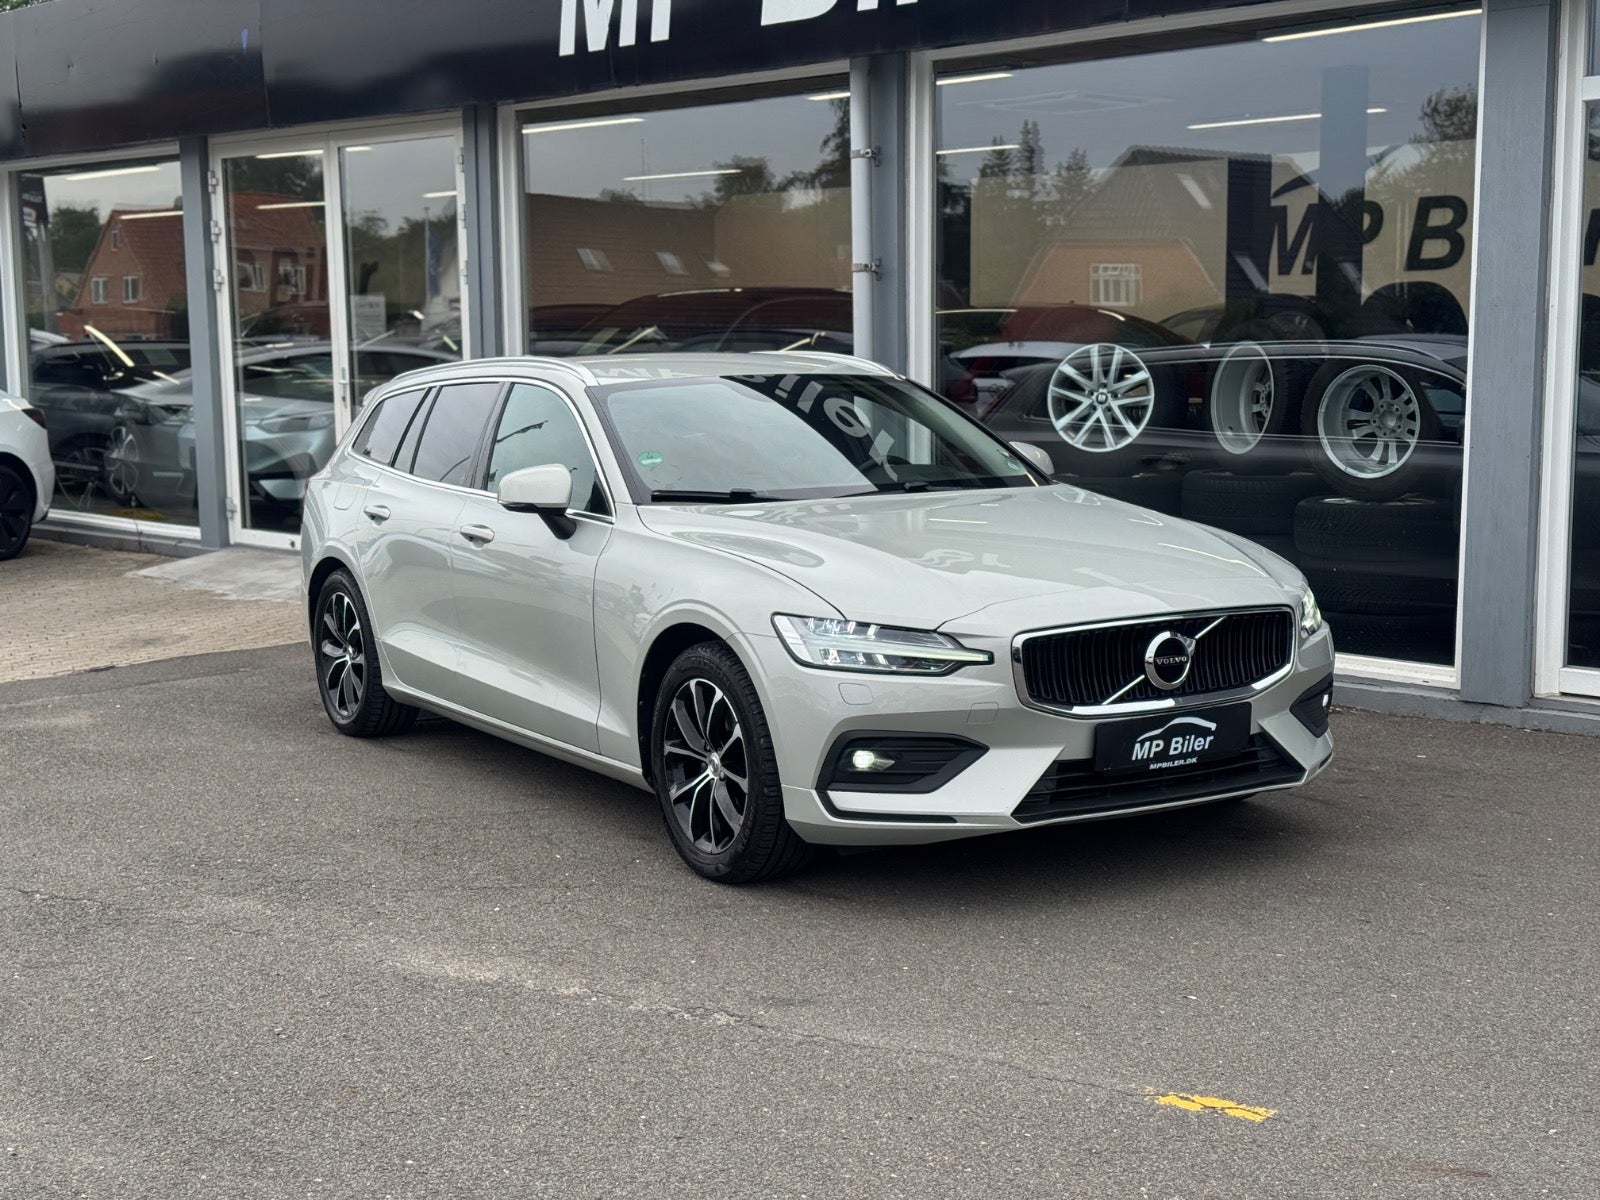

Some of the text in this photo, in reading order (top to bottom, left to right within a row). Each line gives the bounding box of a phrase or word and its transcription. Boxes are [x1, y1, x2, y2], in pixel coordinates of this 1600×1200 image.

[1156, 656, 1187, 665] VOLVO
[1131, 734, 1214, 761] MP Biler
[1149, 757, 1199, 770] MPBILER.DK
